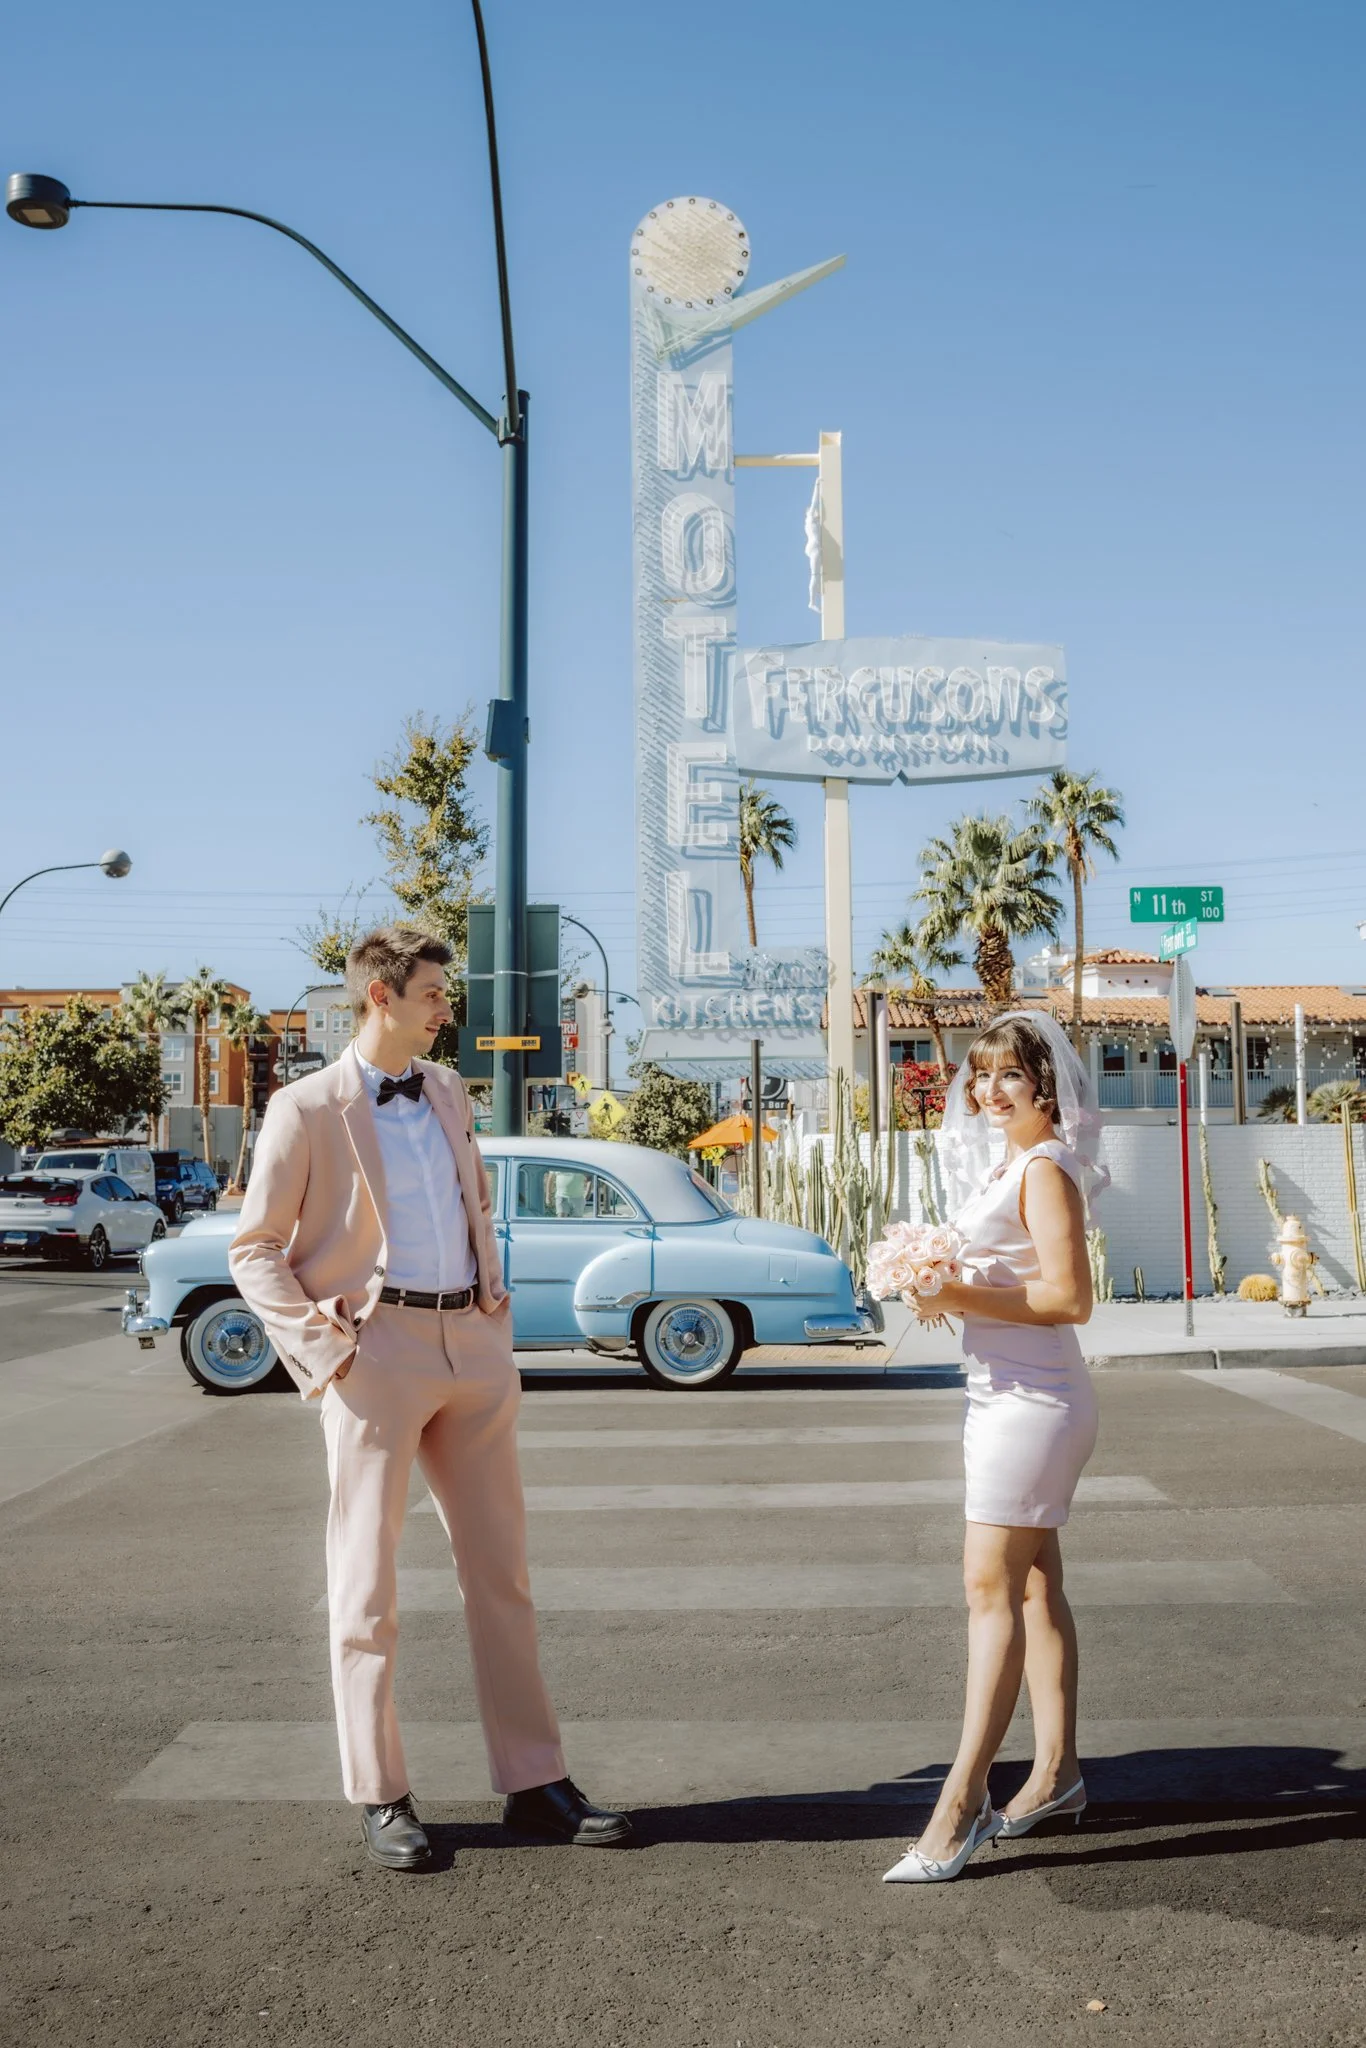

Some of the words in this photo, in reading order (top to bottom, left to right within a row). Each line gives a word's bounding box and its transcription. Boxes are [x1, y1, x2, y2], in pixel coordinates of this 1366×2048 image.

[657, 371, 730, 977] MOTEL
[744, 652, 1057, 728] FERGUSONS
[807, 733, 991, 753] DOWNTOWN
[1133, 891, 1141, 904] N
[1200, 891, 1213, 902] ST
[1202, 907, 1220, 918] 100
[651, 994, 815, 1022] KITCHENS
[768, 1101, 785, 1109] Bar
